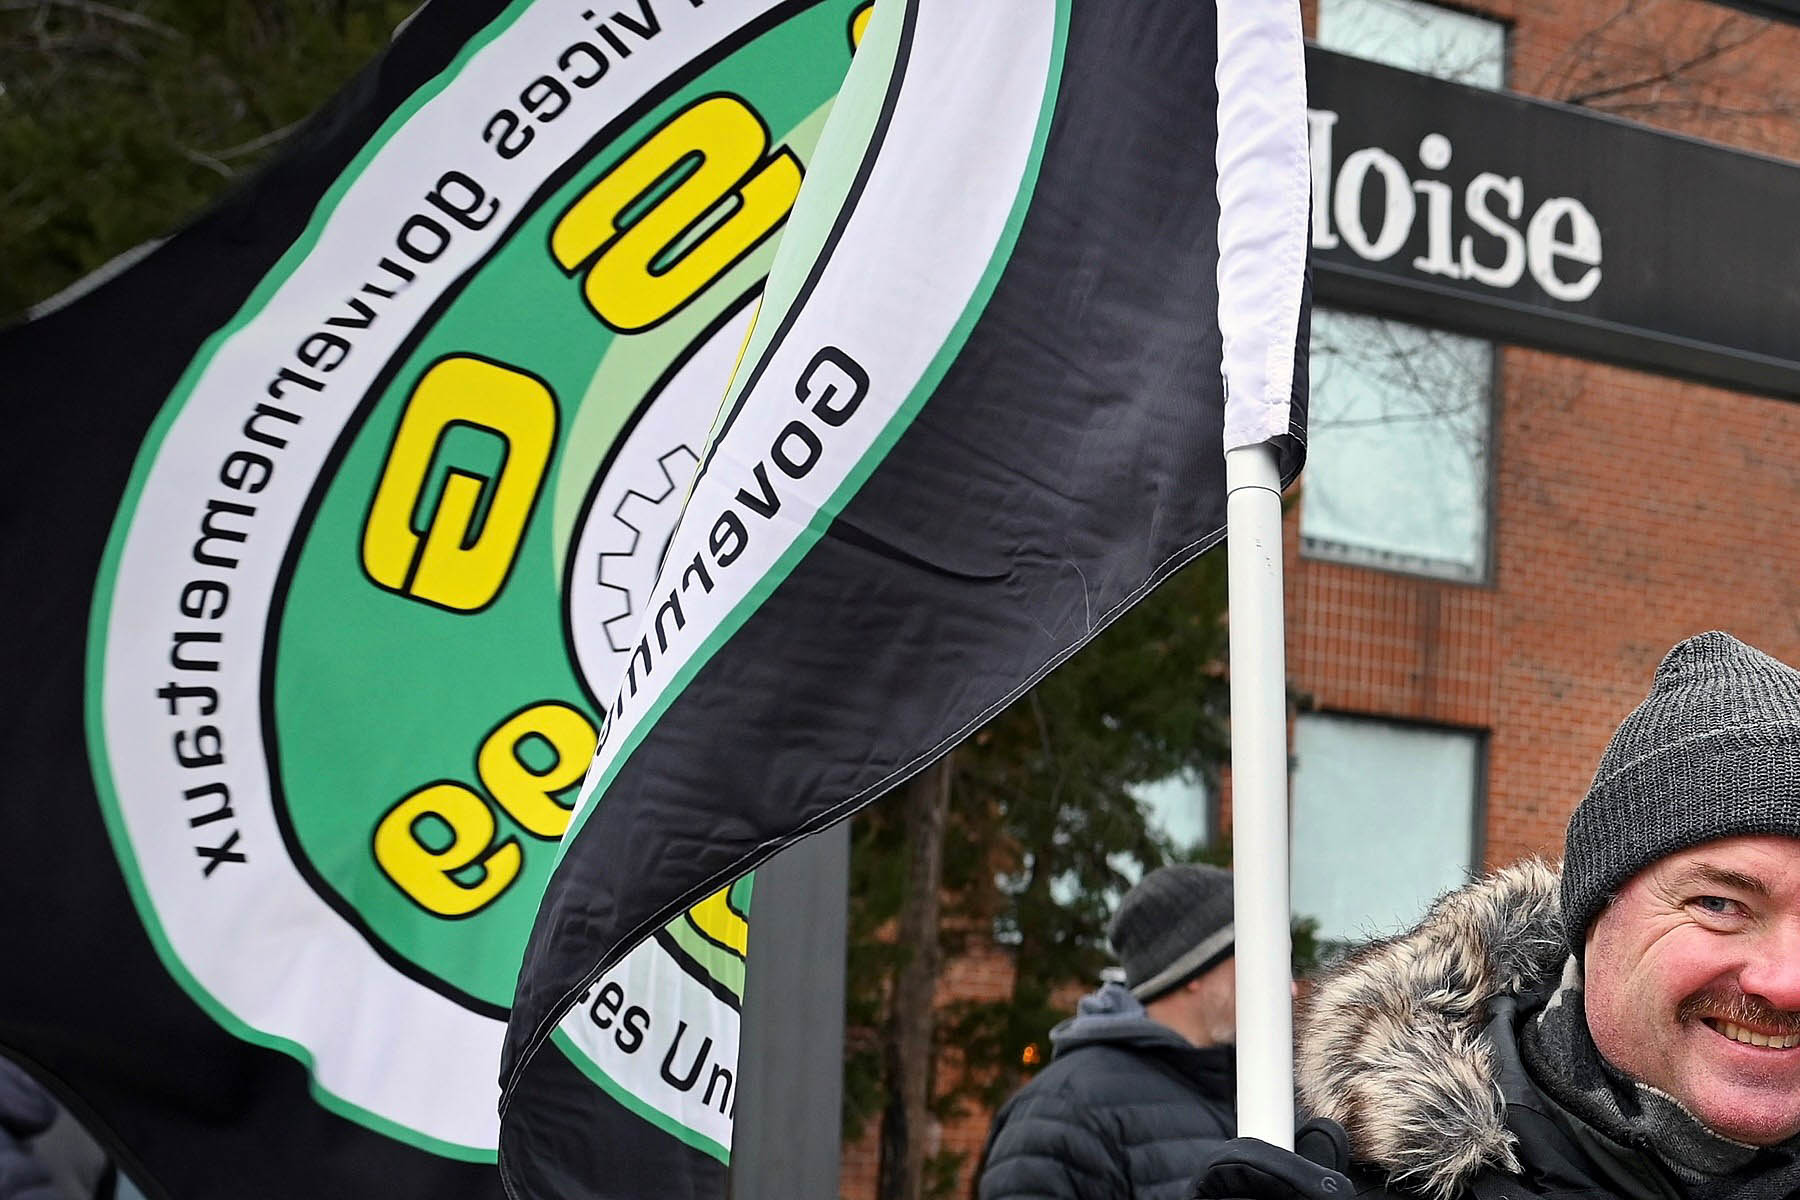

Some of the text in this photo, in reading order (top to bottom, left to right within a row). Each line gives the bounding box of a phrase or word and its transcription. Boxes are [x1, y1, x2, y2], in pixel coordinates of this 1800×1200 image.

[1307, 107, 1603, 303] loise
[578, 976, 735, 1121] es Un
